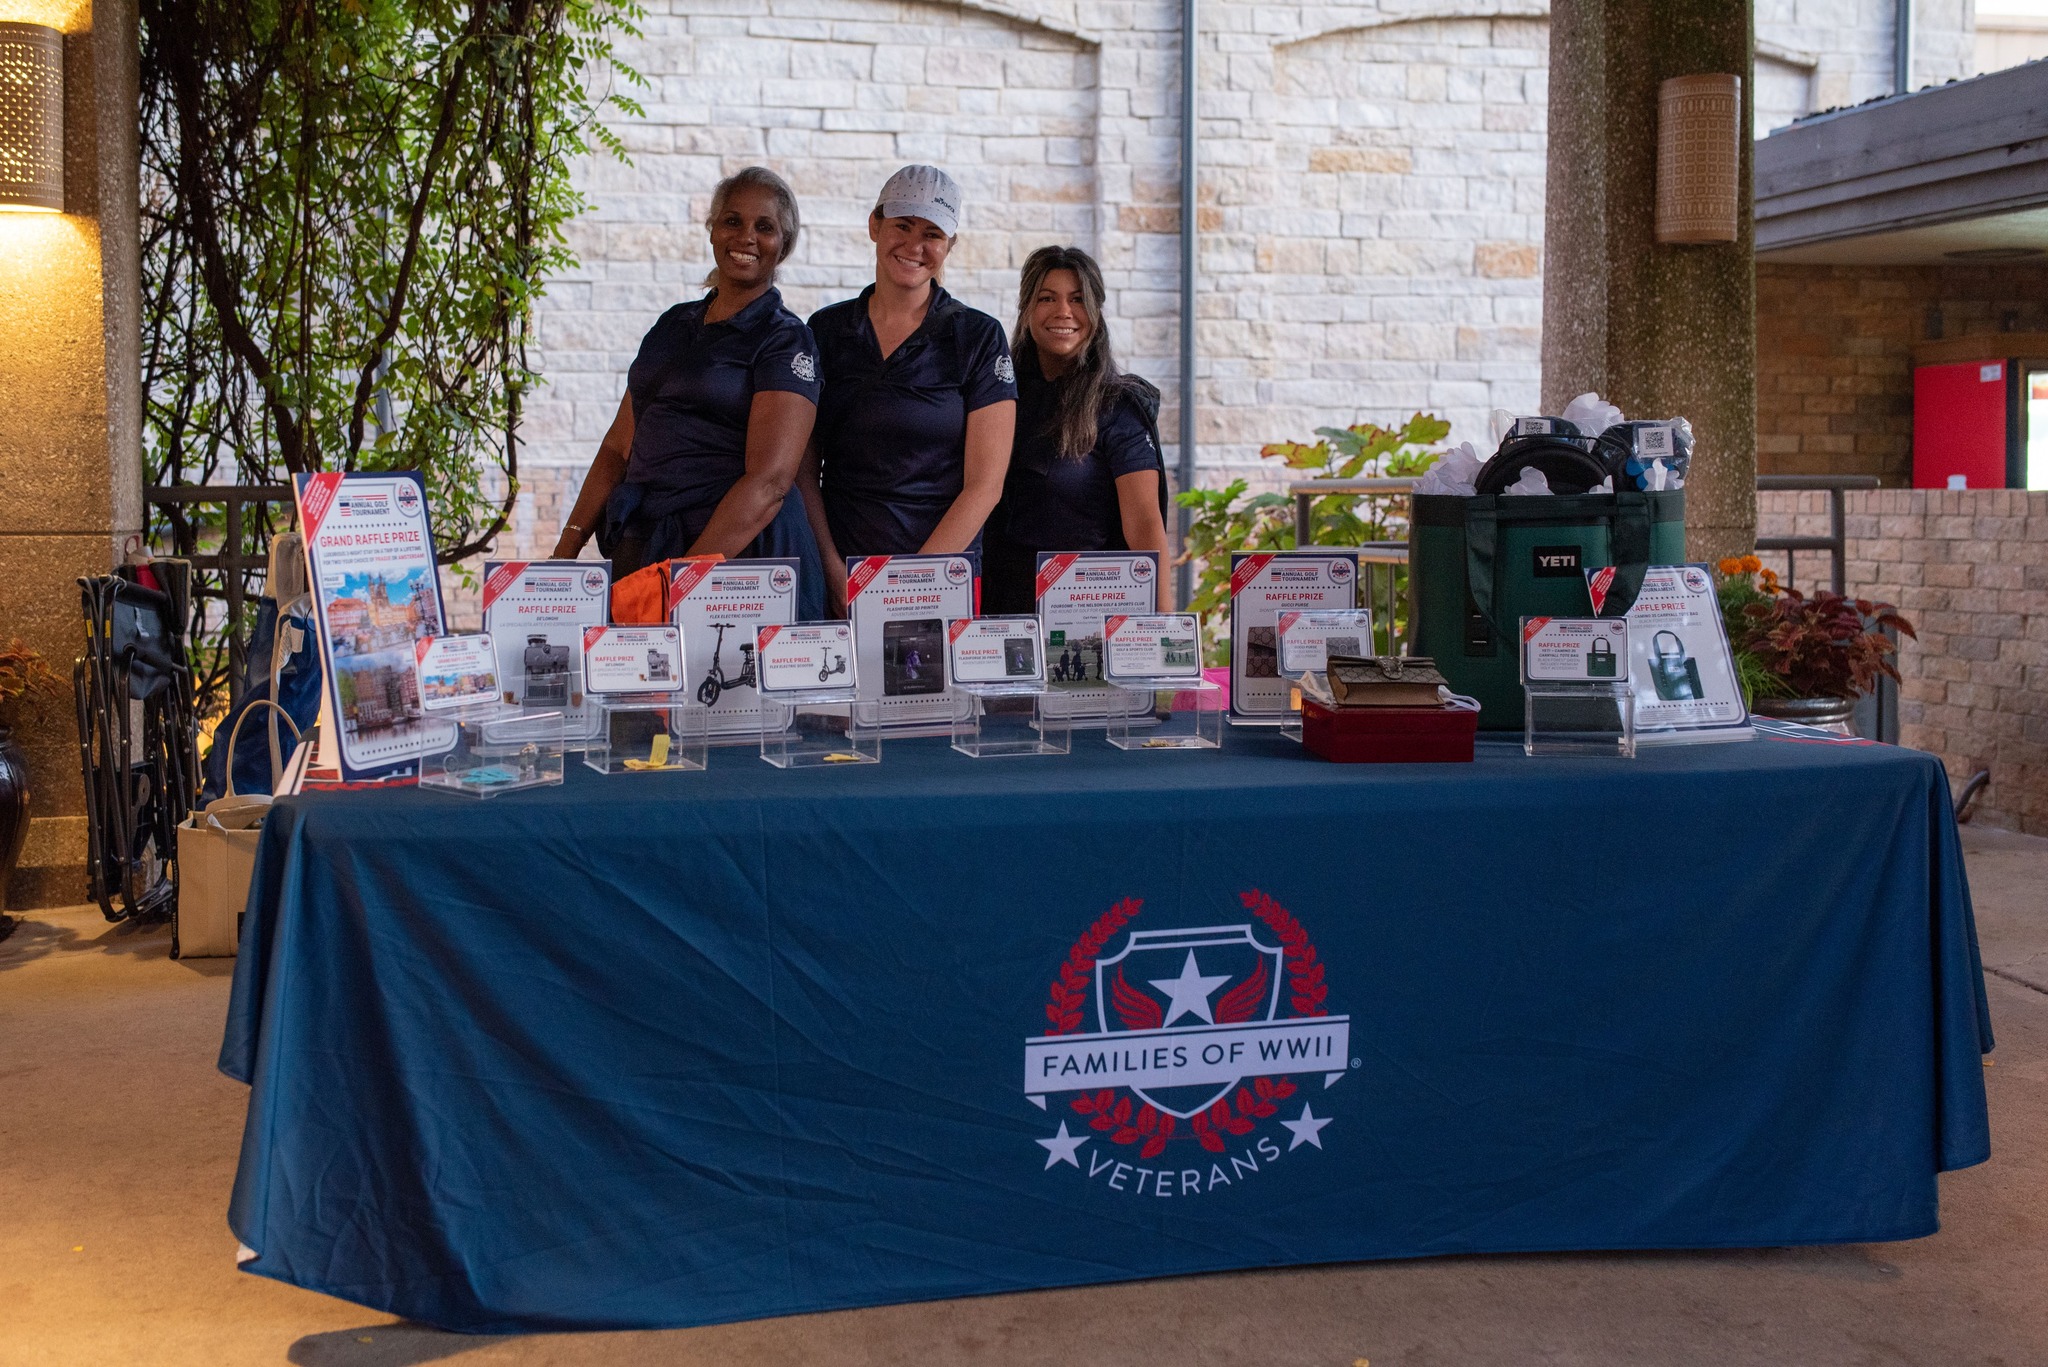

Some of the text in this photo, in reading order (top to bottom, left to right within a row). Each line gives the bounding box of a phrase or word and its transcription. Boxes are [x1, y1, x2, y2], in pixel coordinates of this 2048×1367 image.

[352, 508, 390, 516] TOURNAMENT
[320, 531, 420, 547] GRAND RAFFLE PRIZE
[1539, 555, 1575, 567] YETI
[884, 595, 942, 605] RAFFLE PRIZE
[1070, 593, 1100, 601] RAFFLE
[1265, 593, 1297, 601] RAFFLE
[518, 605, 577, 614] RAFFLE PRIZE
[706, 603, 765, 612] RAFFLE PRIZE
[1043, 1036, 1332, 1077] FAMILIES OF WWII
[1088, 1137, 1280, 1197] VETERANS
